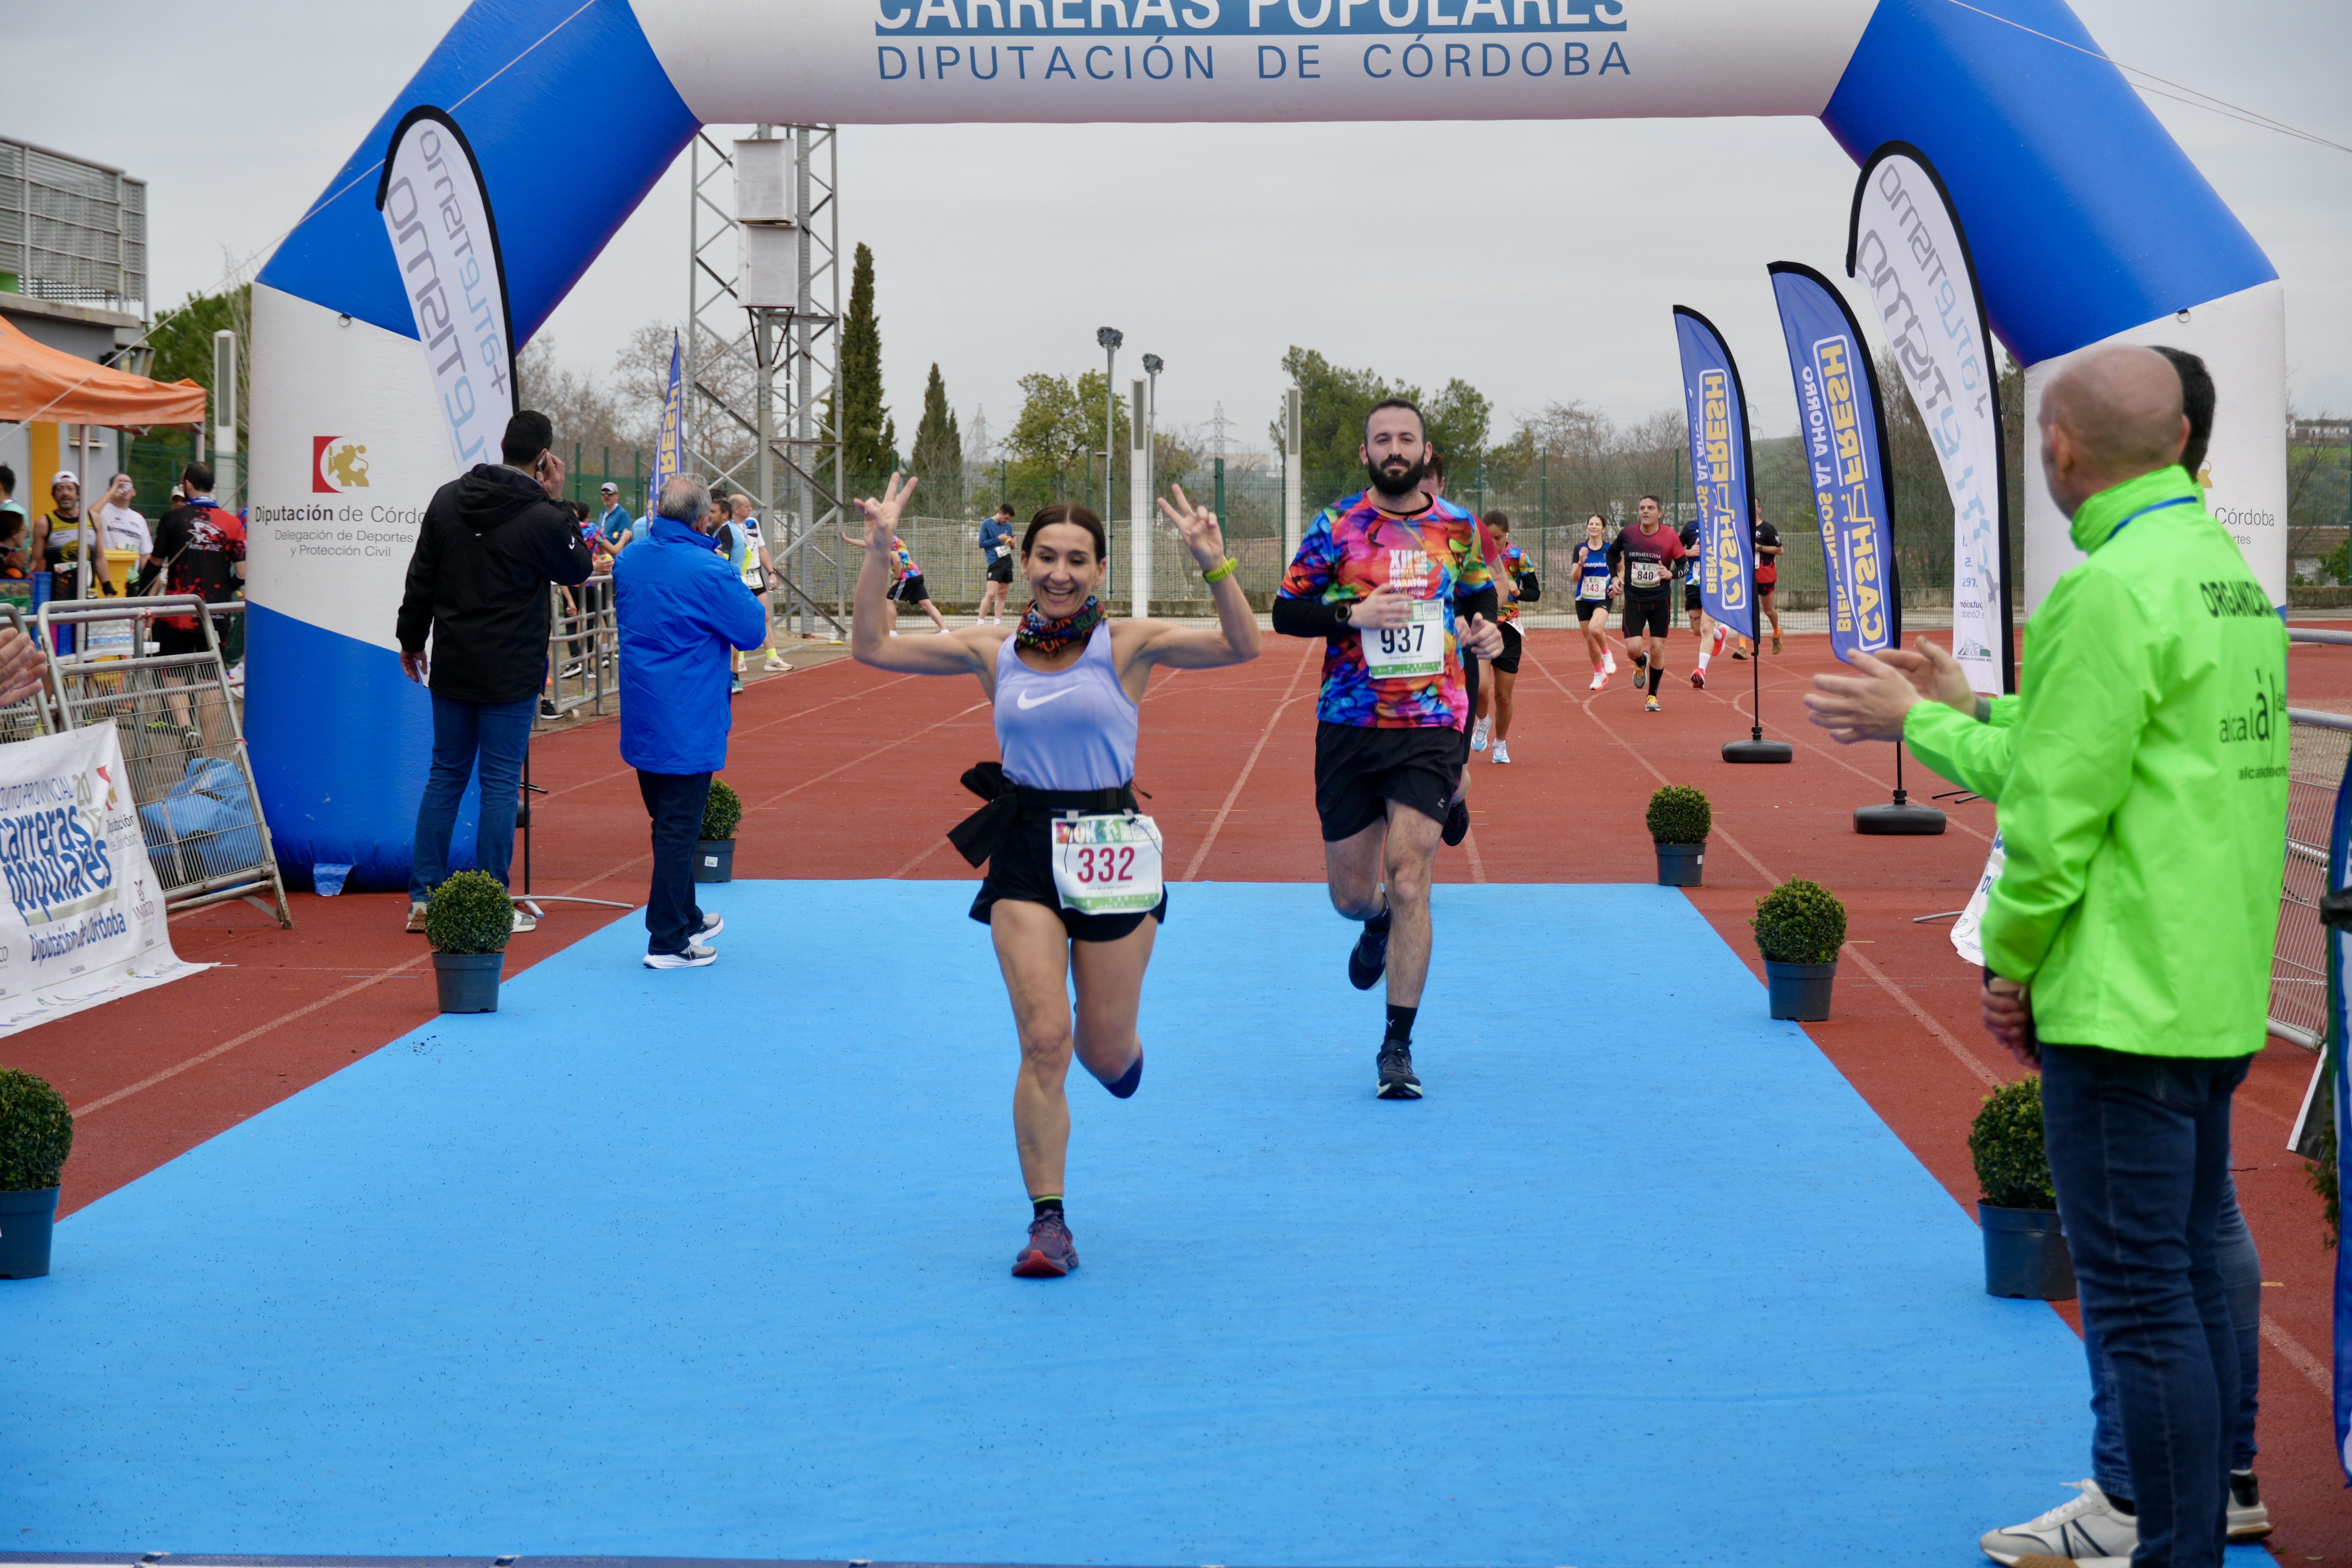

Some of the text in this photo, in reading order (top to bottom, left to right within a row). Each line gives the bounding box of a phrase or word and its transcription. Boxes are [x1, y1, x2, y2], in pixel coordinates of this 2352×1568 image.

[877, 35, 1631, 80] DIPUTACIÓN DE CÓRDOBA
[256, 505, 333, 525] Diputación
[339, 506, 363, 522] de
[2215, 507, 2275, 526] Córdoba
[275, 530, 413, 544] Delegación de Deportes
[2233, 534, 2251, 544] rtes
[299, 545, 360, 556] Protección
[365, 546, 391, 557] Civil
[1389, 569, 1414, 578] MEDIA
[1638, 571, 1653, 580] 840
[1389, 577, 1428, 588] MARATÓN
[1586, 583, 1599, 592] 143
[1380, 625, 1424, 654] 937
[1077, 847, 1135, 883] 332
[3, 839, 112, 926] populares
[29, 923, 78, 967] Diputación
[87, 908, 127, 945] Córdoba
